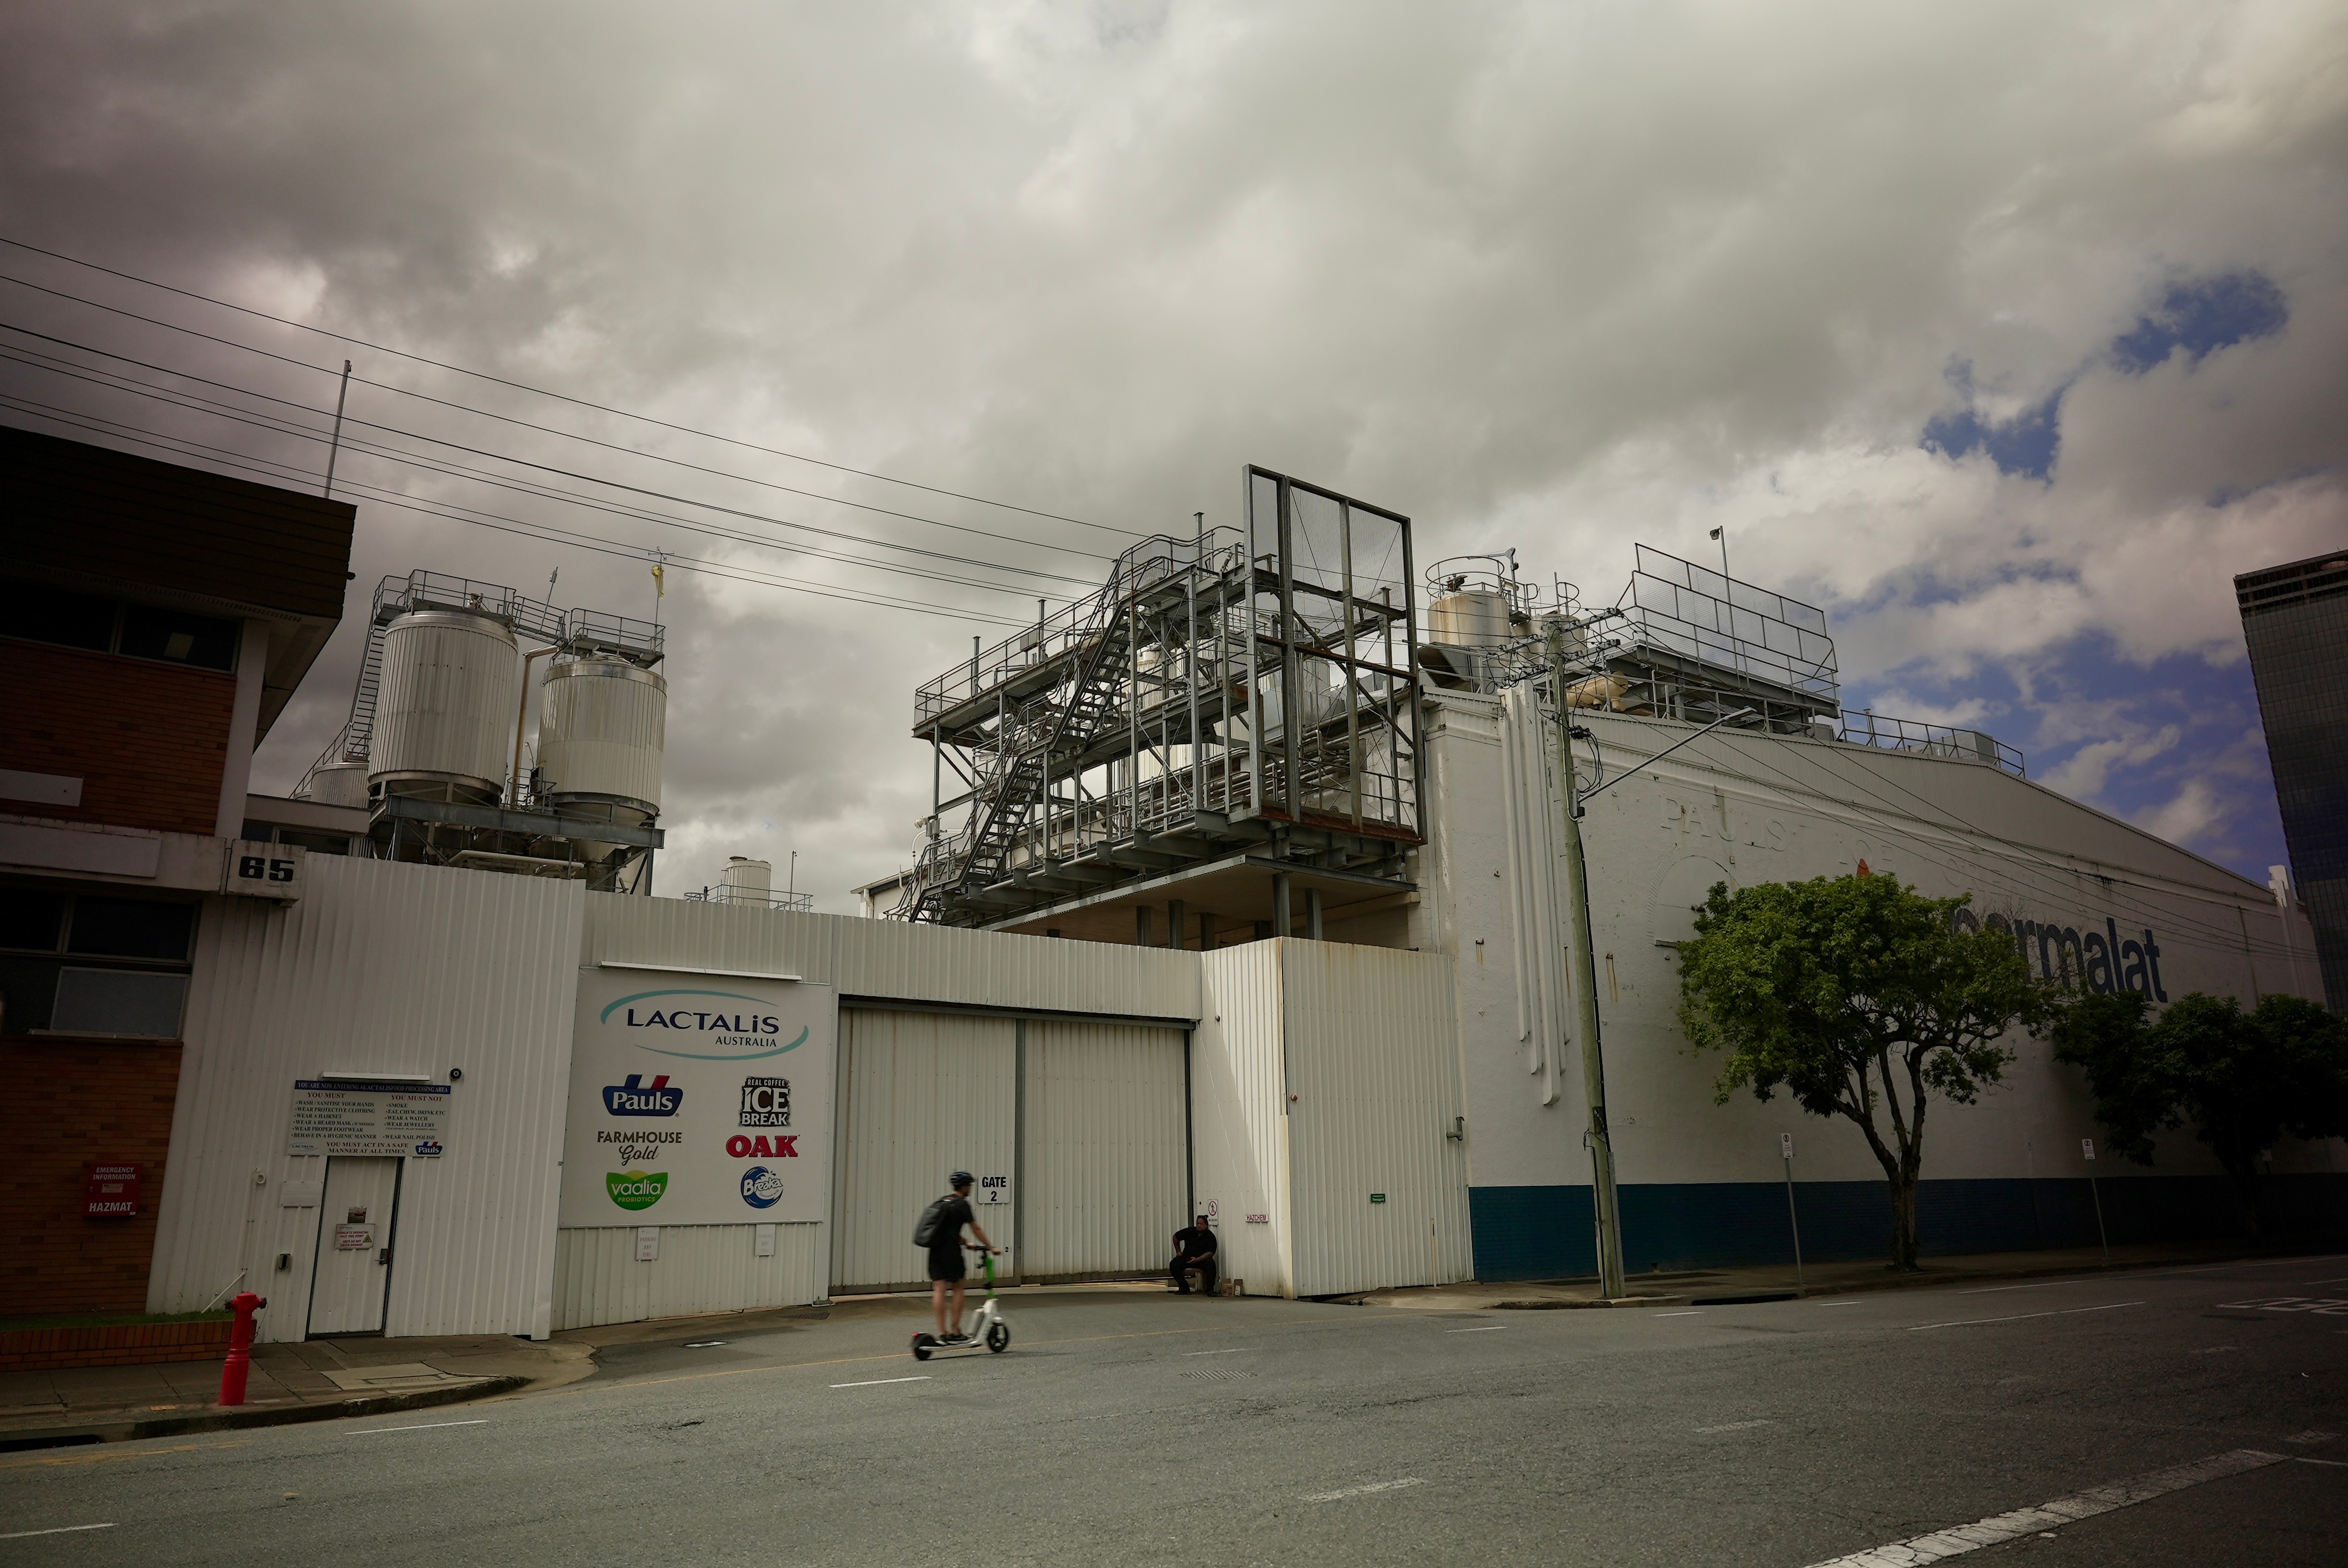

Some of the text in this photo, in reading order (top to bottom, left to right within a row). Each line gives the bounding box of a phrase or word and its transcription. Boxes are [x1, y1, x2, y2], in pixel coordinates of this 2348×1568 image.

[1658, 793, 1788, 852] PAULS
[239, 856, 295, 882] 65
[715, 1036, 777, 1048] AUSTRALIA
[612, 1091, 673, 1111] Pauls
[742, 1086, 789, 1113] ICE
[742, 1113, 789, 1126] BREAK
[597, 1131, 682, 1143] FARMHOUSE
[725, 1134, 798, 1158] OAK
[619, 1144, 660, 1166] Gold
[611, 1179, 662, 1196] vaalia
[743, 1177, 784, 1196] Breaka
[982, 1177, 1006, 1188] GATE
[991, 1191, 997, 1201] 2
[89, 1202, 133, 1212] HAZMAT
